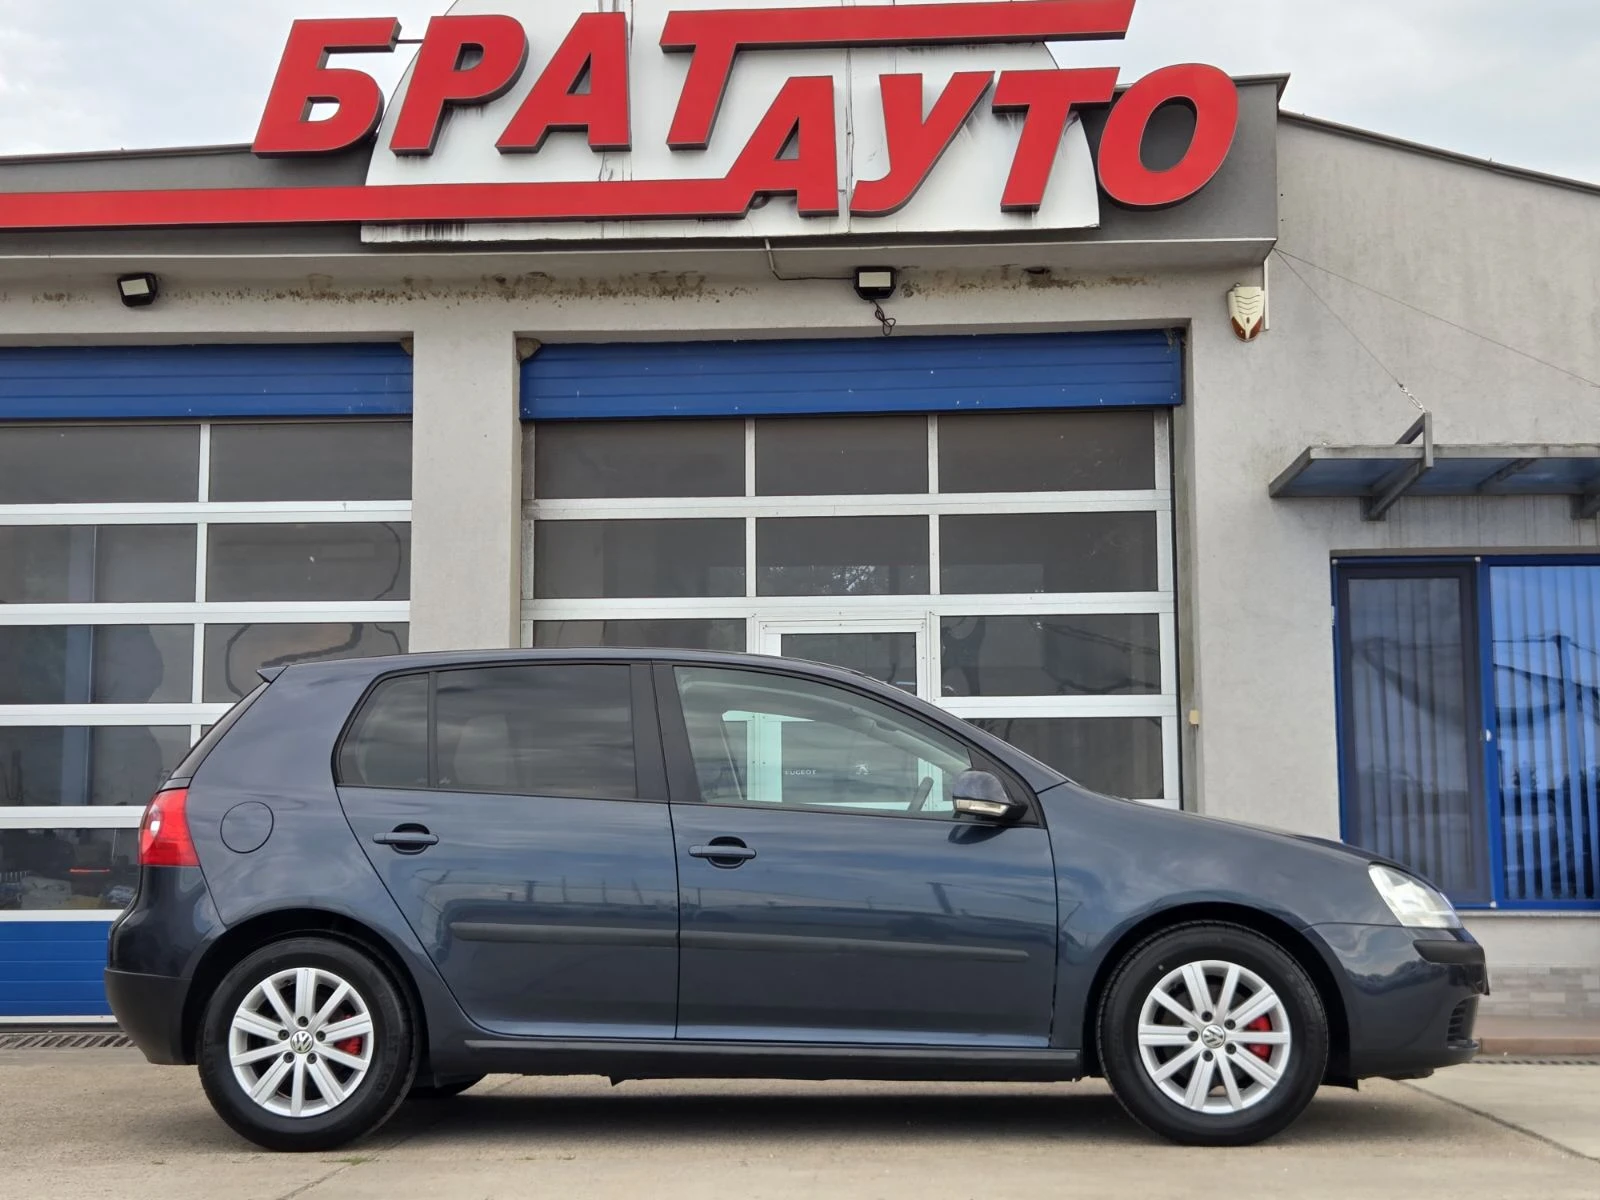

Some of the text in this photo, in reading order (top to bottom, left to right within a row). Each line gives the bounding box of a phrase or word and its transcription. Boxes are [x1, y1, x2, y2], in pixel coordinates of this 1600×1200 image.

[252, 0, 1135, 159] БРАТ
[722, 63, 1239, 217] АУТО
[290, 1030, 314, 1055] VW
